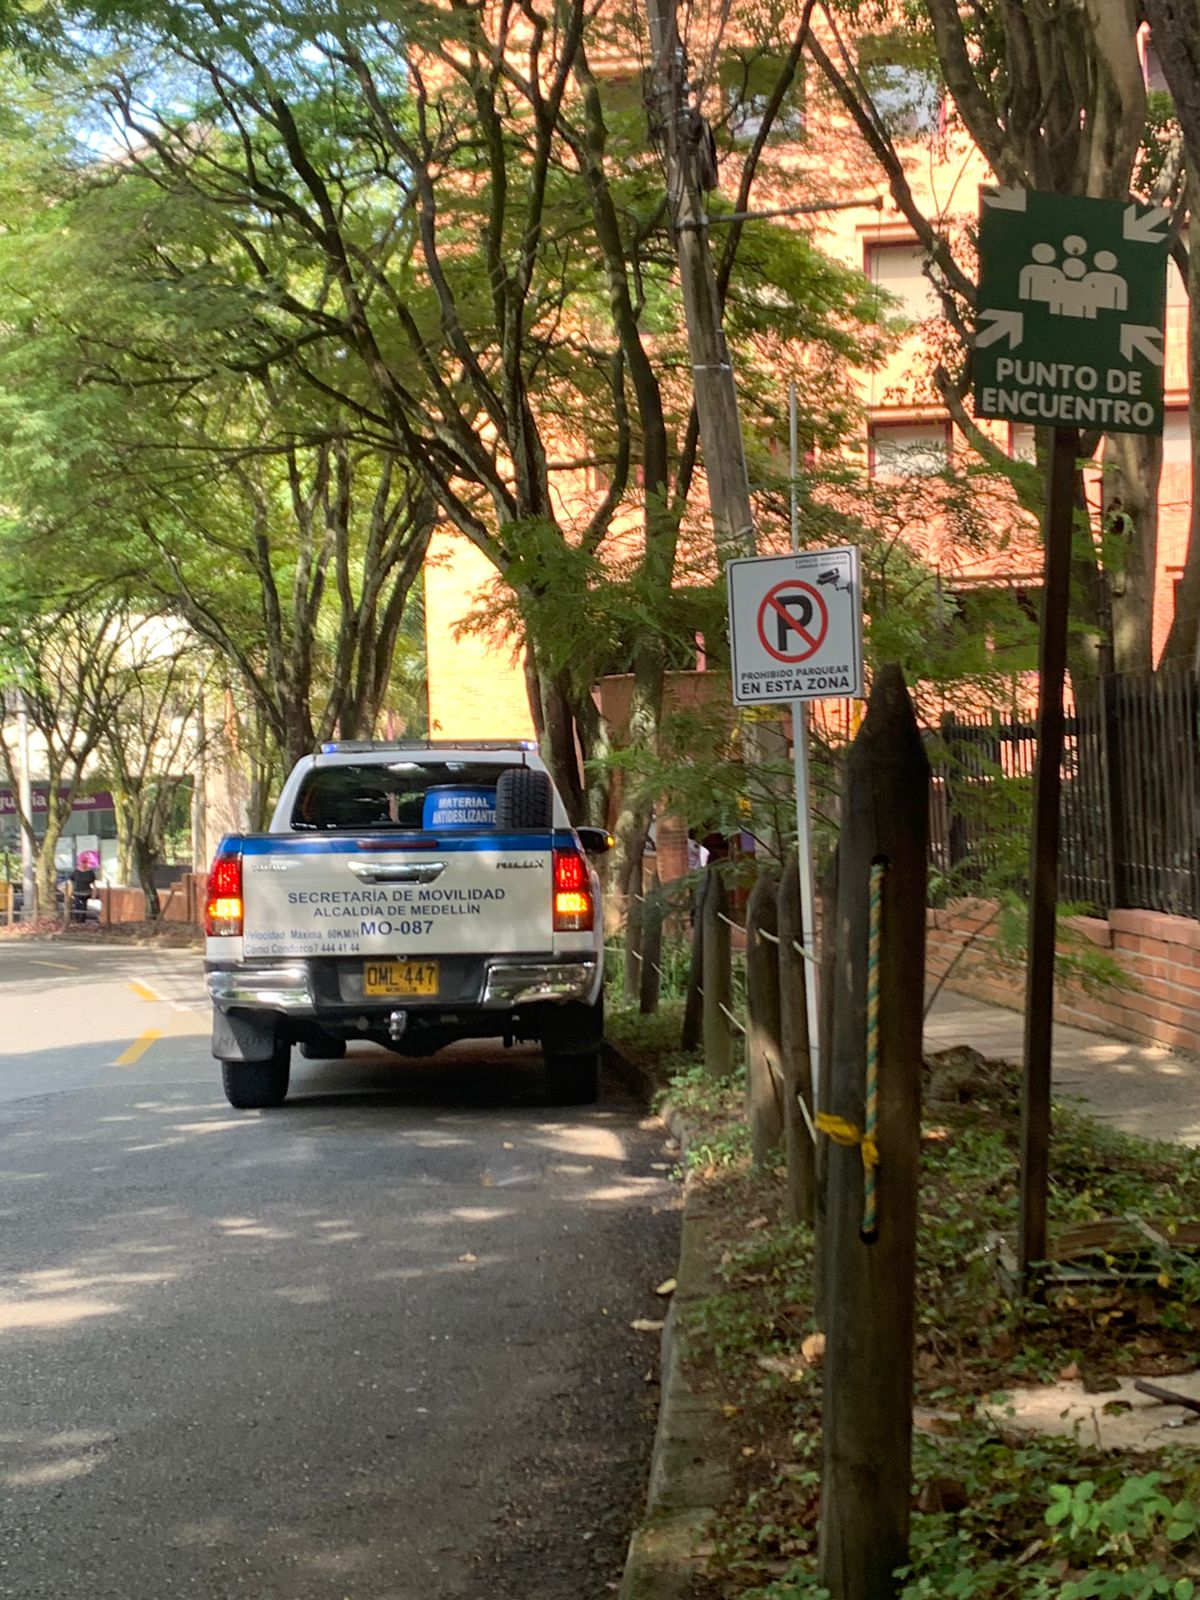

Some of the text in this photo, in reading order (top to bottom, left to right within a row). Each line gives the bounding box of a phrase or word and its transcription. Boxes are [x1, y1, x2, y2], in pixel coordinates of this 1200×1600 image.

[996, 358, 1142, 395] PUNTO DE
[982, 387, 1155, 426] ENCUENTRO
[776, 594, 813, 652] P
[741, 665, 849, 680] PROHIBIDO PARQUEAR
[741, 676, 850, 694] EN ESTA ZONA
[438, 797, 490, 809] MATERIAL
[432, 809, 496, 824] ANTIDESLIZANTE
[288, 888, 505, 904] SECRETARÍA DE MOVILIDAD
[313, 904, 480, 917] ALCALDÍA DE MEDELLÍN
[360, 920, 434, 936] MO-087
[321, 943, 335, 952] 444
[338, 943, 347, 952] 41
[351, 943, 360, 952] 44
